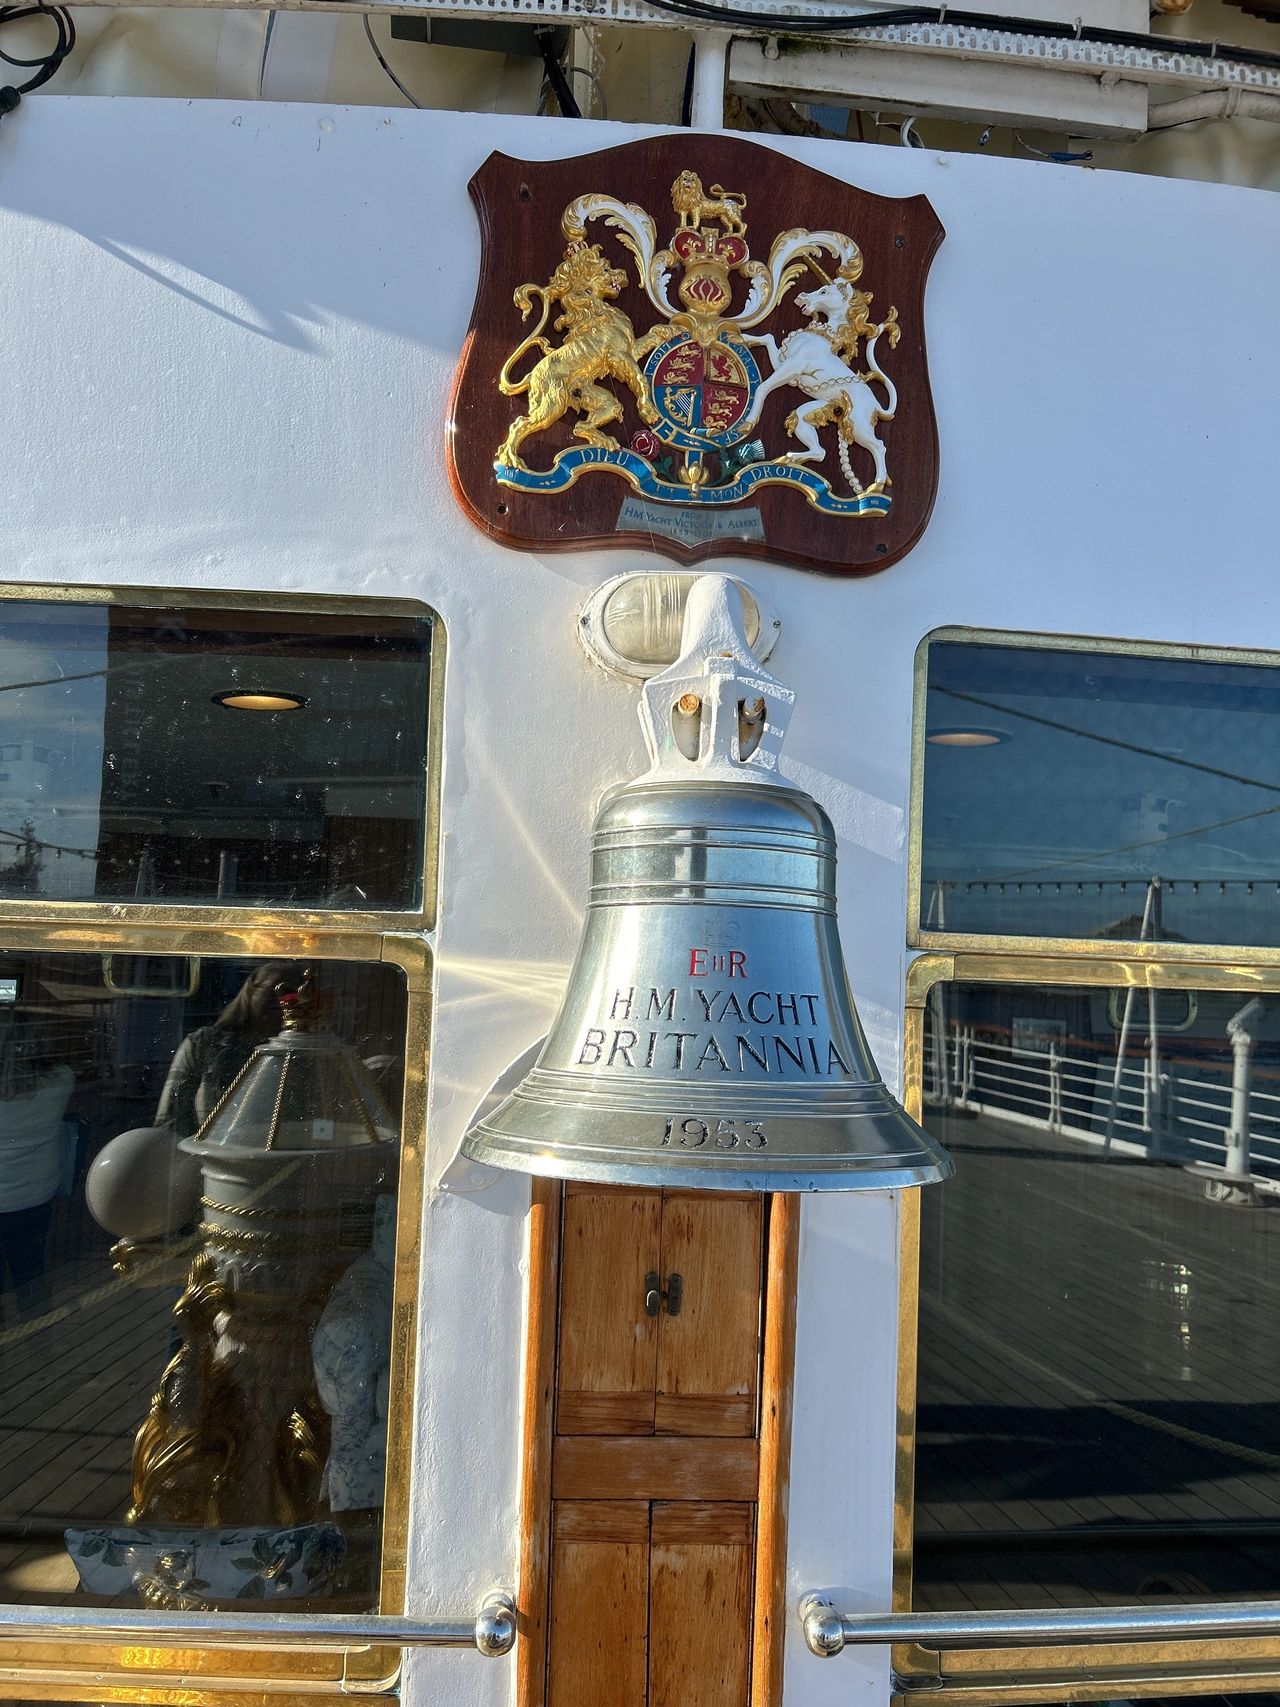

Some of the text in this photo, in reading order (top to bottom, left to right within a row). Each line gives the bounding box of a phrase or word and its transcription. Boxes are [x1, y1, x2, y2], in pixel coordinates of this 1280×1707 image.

[580, 448, 630, 466] DIEU
[710, 483, 743, 500] MON
[750, 466, 809, 482] DROIT
[625, 506, 643, 520] HM
[645, 512, 672, 526] YACHT
[728, 520, 758, 529] ALBERT
[696, 989, 819, 1026] YACHT
[661, 1116, 769, 1150] 1953
